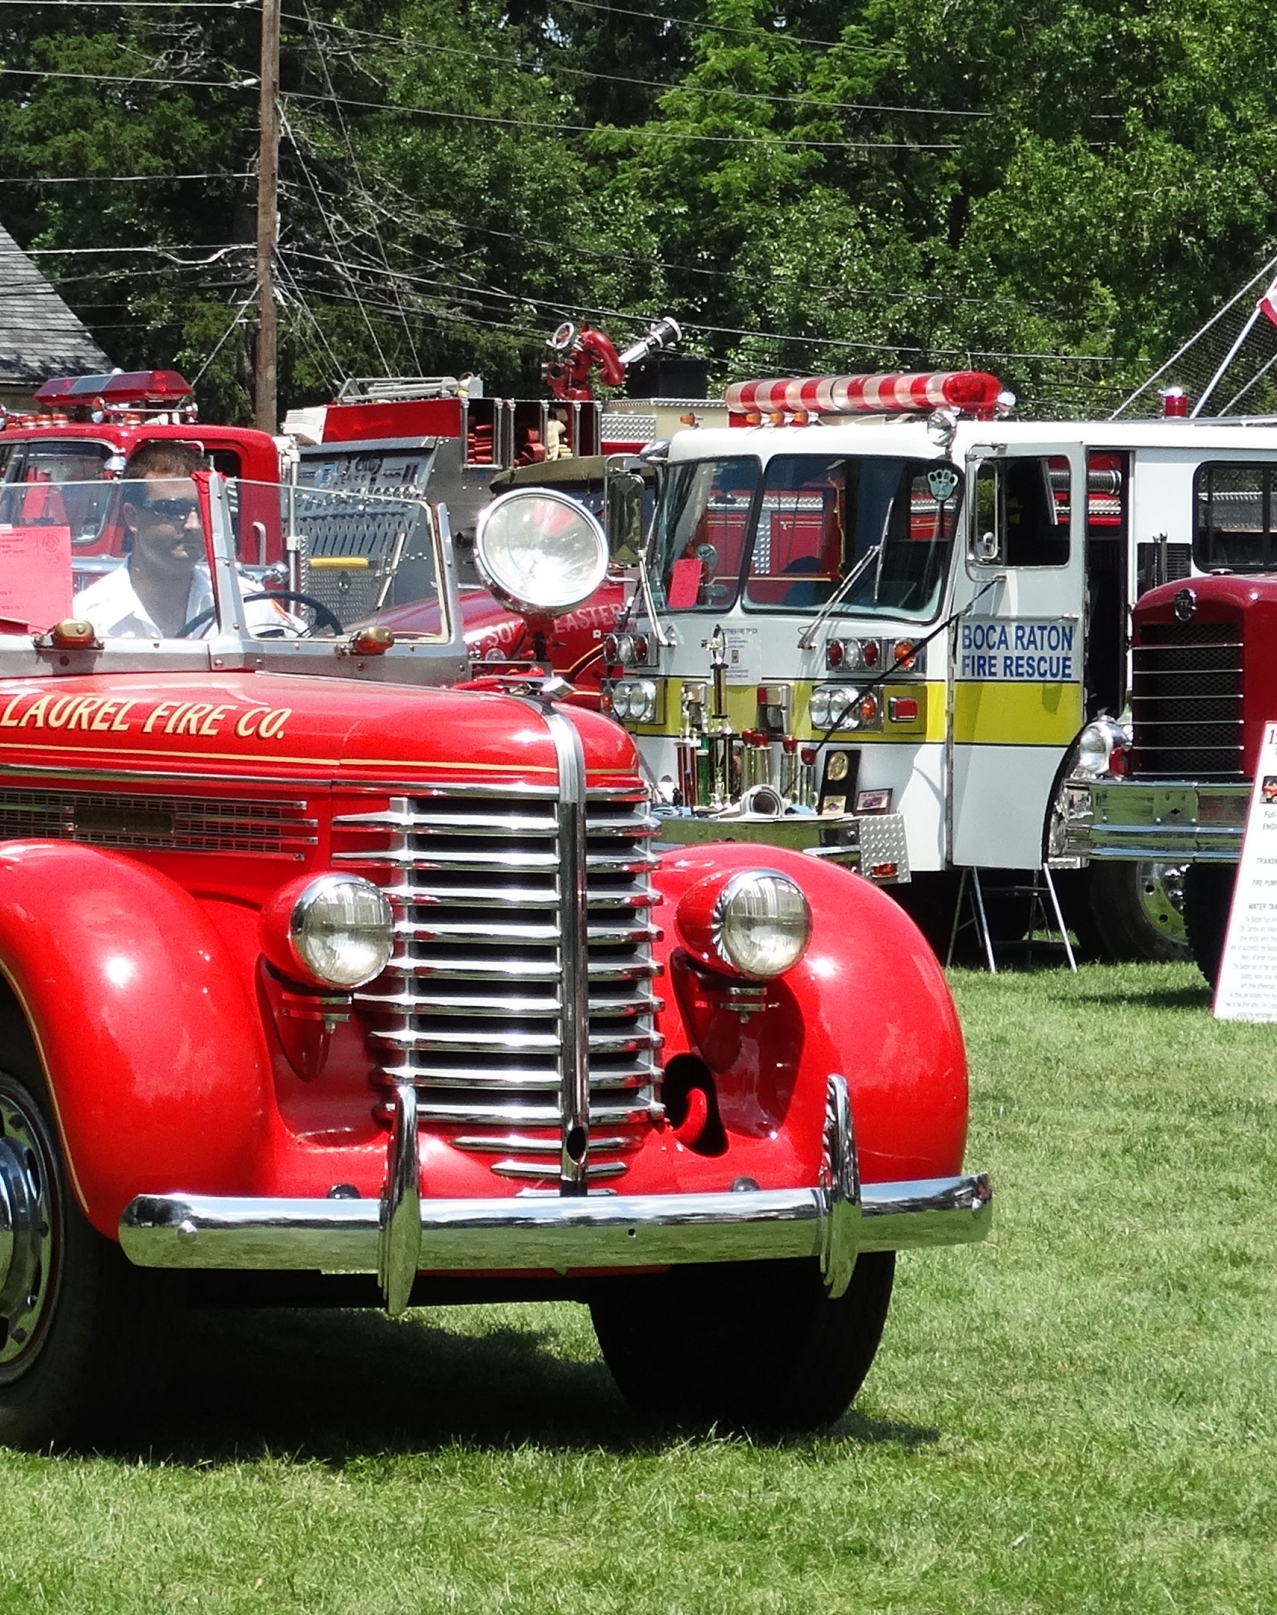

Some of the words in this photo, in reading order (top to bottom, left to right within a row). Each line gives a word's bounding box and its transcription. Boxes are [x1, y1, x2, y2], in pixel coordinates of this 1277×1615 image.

[962, 624, 1009, 650] BOCA
[1014, 625, 1073, 651] RATON
[962, 655, 997, 677] FIRE
[1003, 655, 1072, 678] RESCUE
[0, 693, 137, 732] LAUREL
[142, 700, 238, 735] FIRE
[233, 705, 293, 740] CO.
